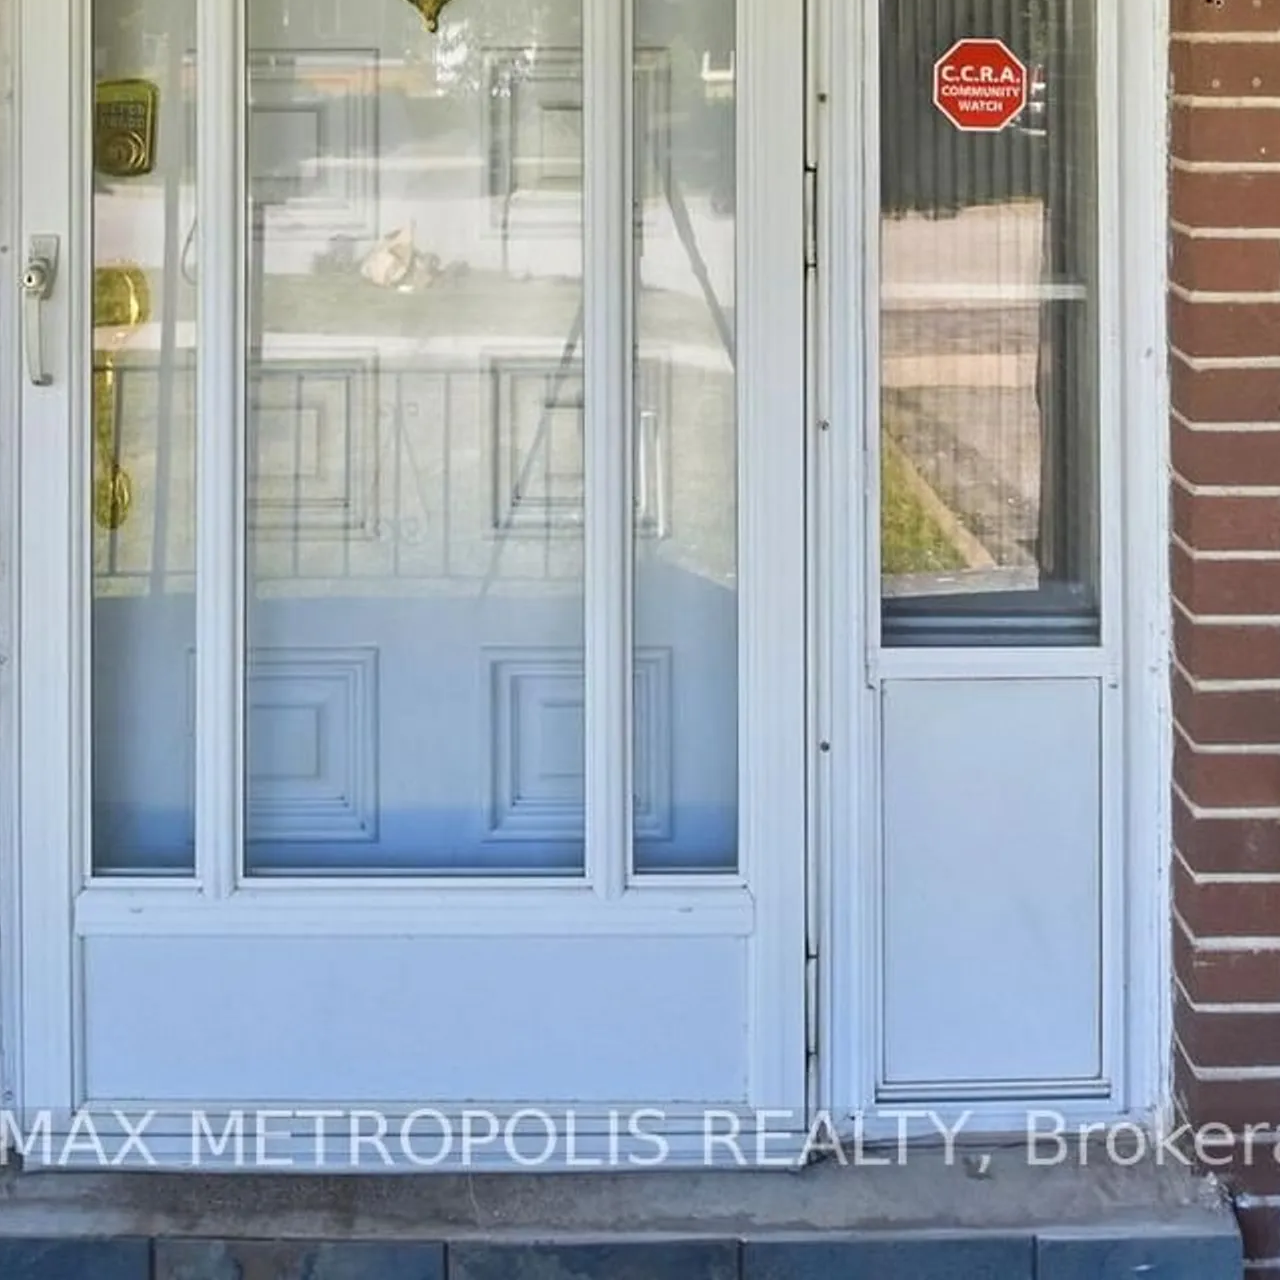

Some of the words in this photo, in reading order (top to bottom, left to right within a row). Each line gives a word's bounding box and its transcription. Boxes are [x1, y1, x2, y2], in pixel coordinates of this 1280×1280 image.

[941, 65, 1021, 82] C.C.R.A.
[941, 84, 1021, 97] COMMUNITY
[958, 100, 1004, 112] WATCH
